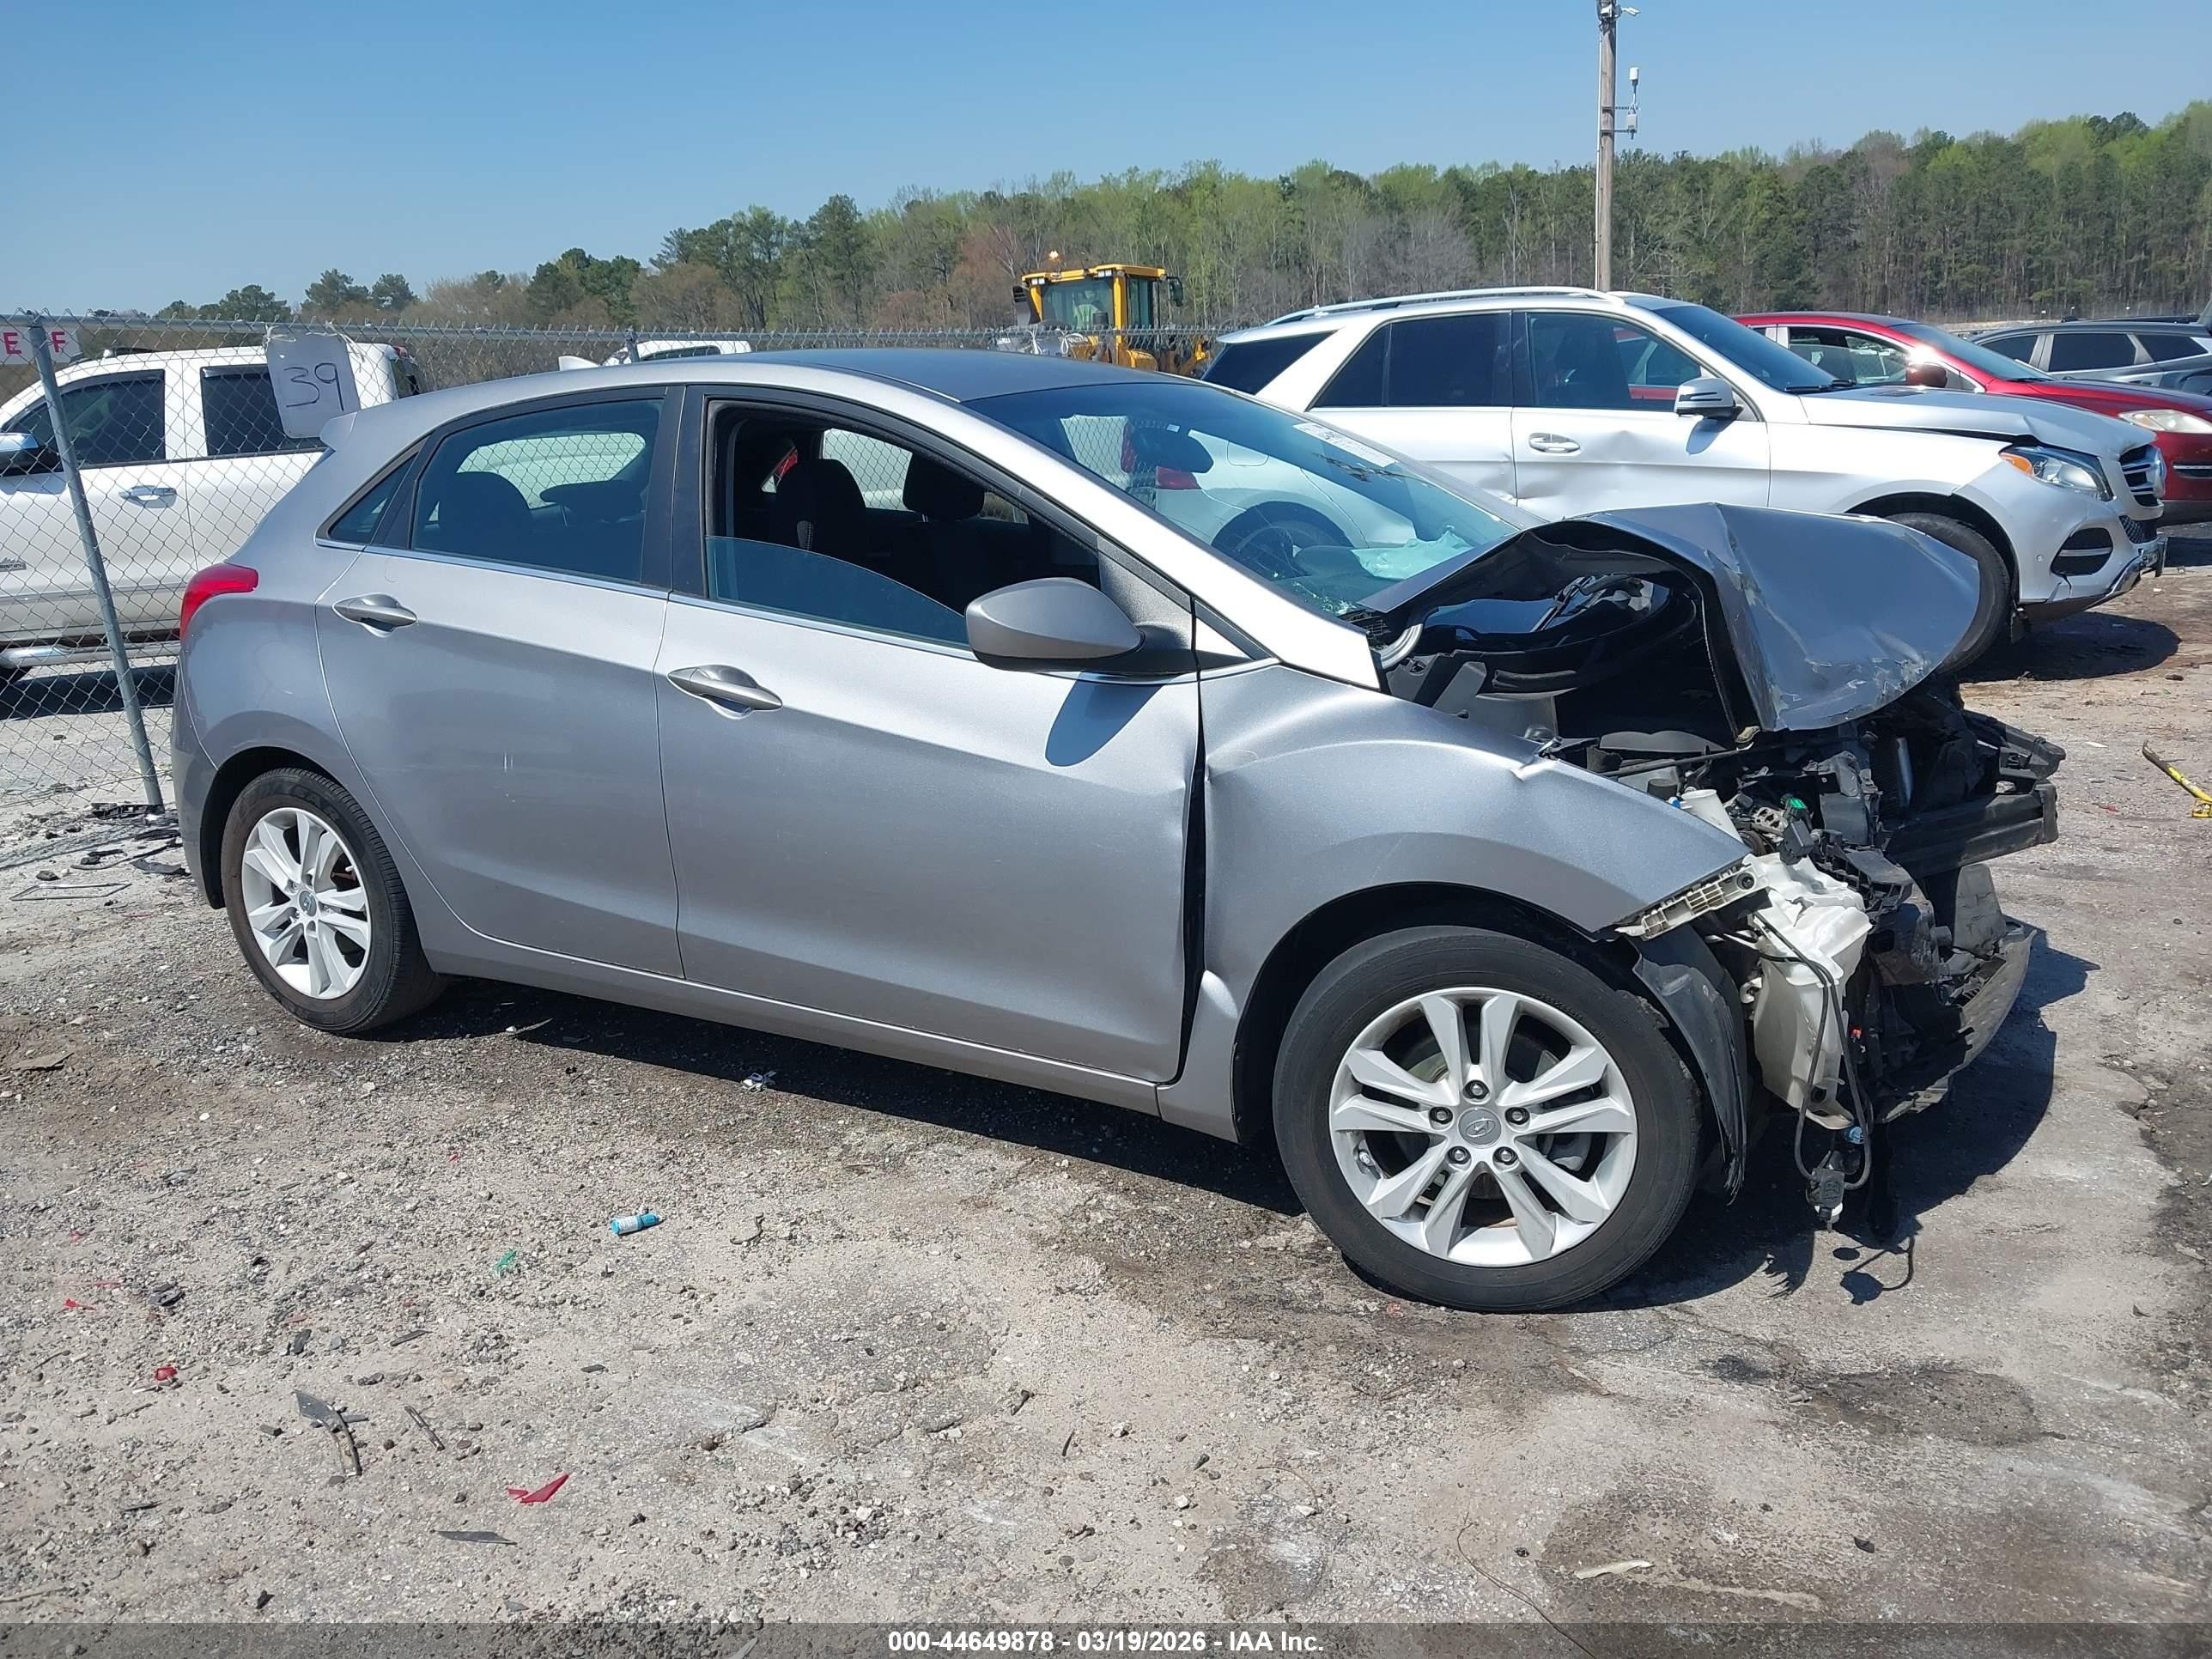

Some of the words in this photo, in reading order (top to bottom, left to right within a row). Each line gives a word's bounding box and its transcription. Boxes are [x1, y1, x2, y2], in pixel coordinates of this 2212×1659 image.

[3, 331, 22, 355] E
[51, 331, 66, 353] F
[283, 362, 345, 412] 39
